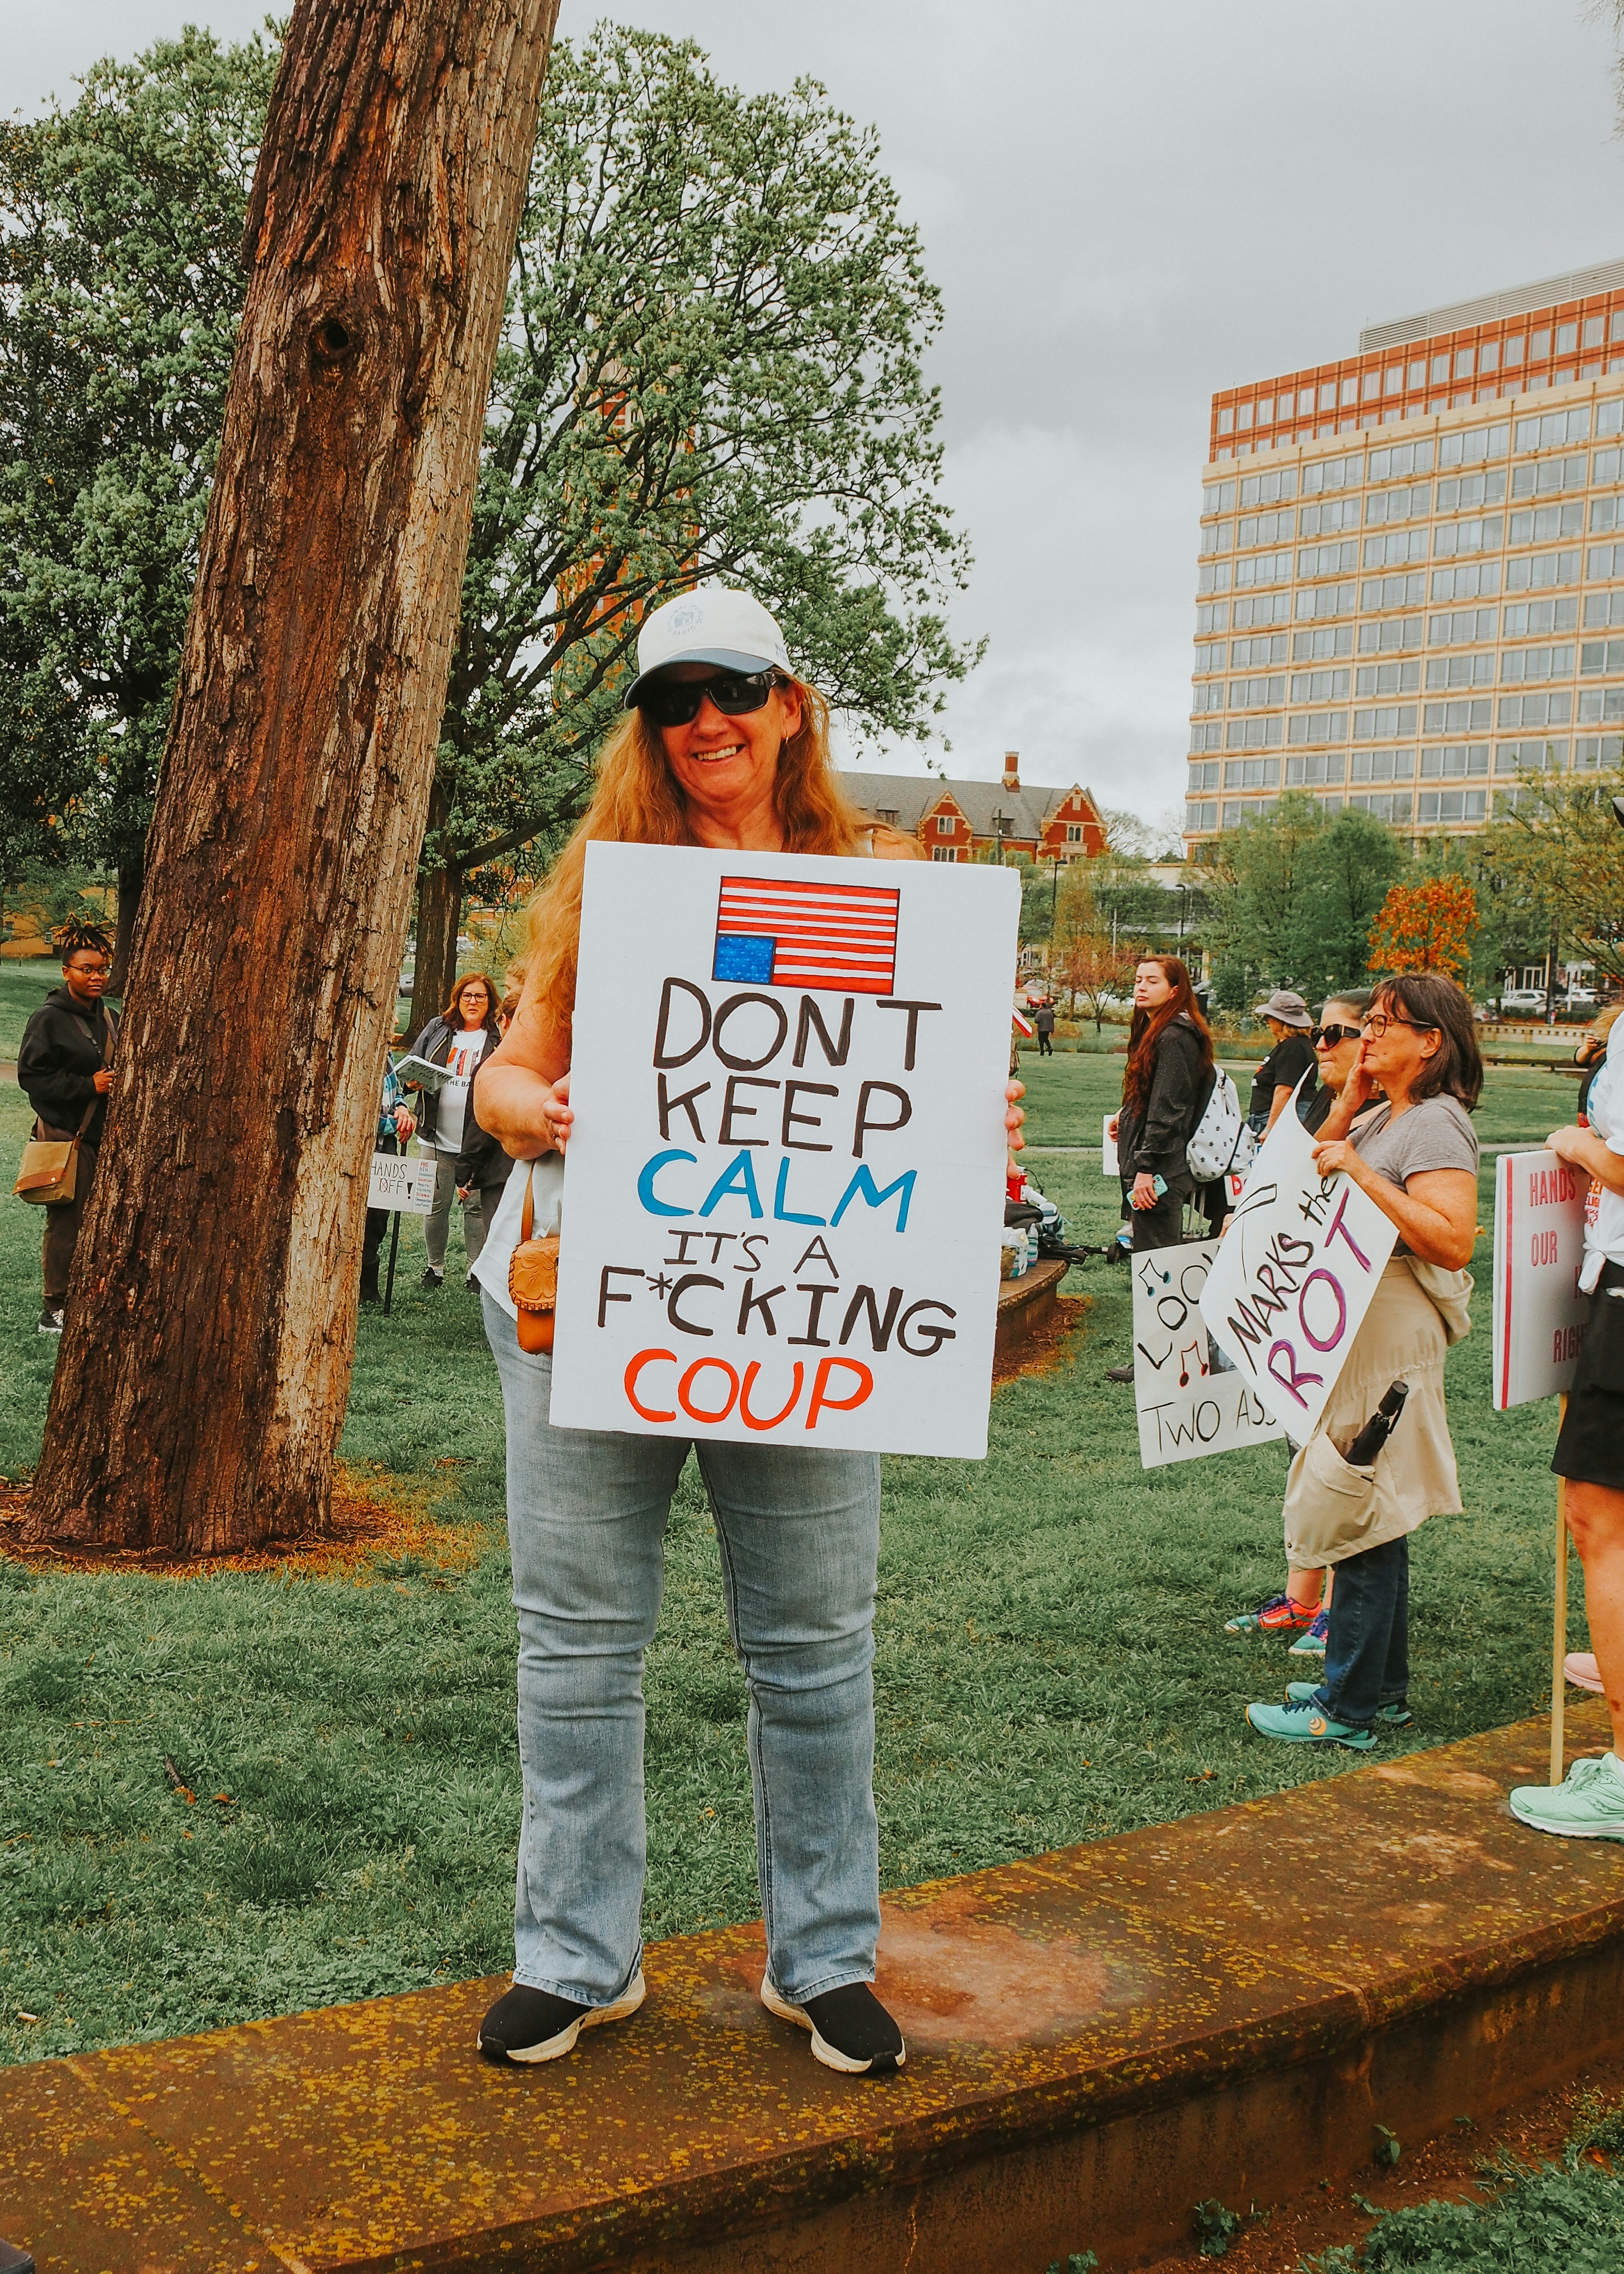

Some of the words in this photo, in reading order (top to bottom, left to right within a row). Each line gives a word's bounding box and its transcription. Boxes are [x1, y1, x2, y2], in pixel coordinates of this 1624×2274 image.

[658, 1072, 912, 1157] KEEP
[637, 1148, 918, 1233] CALM
[1529, 1167, 1576, 1207] HANDS
[663, 1229, 769, 1272] IT'S
[793, 1234, 840, 1279] A
[1227, 1232, 1314, 1376] MARKS
[1298, 1176, 1339, 1226] the
[1531, 1230, 1557, 1267] OUR
[1267, 1187, 1372, 1411] ROT
[624, 1348, 873, 1431] COUP
[1140, 1400, 1221, 1455] TWO
[1235, 1389, 1277, 1430] AS
